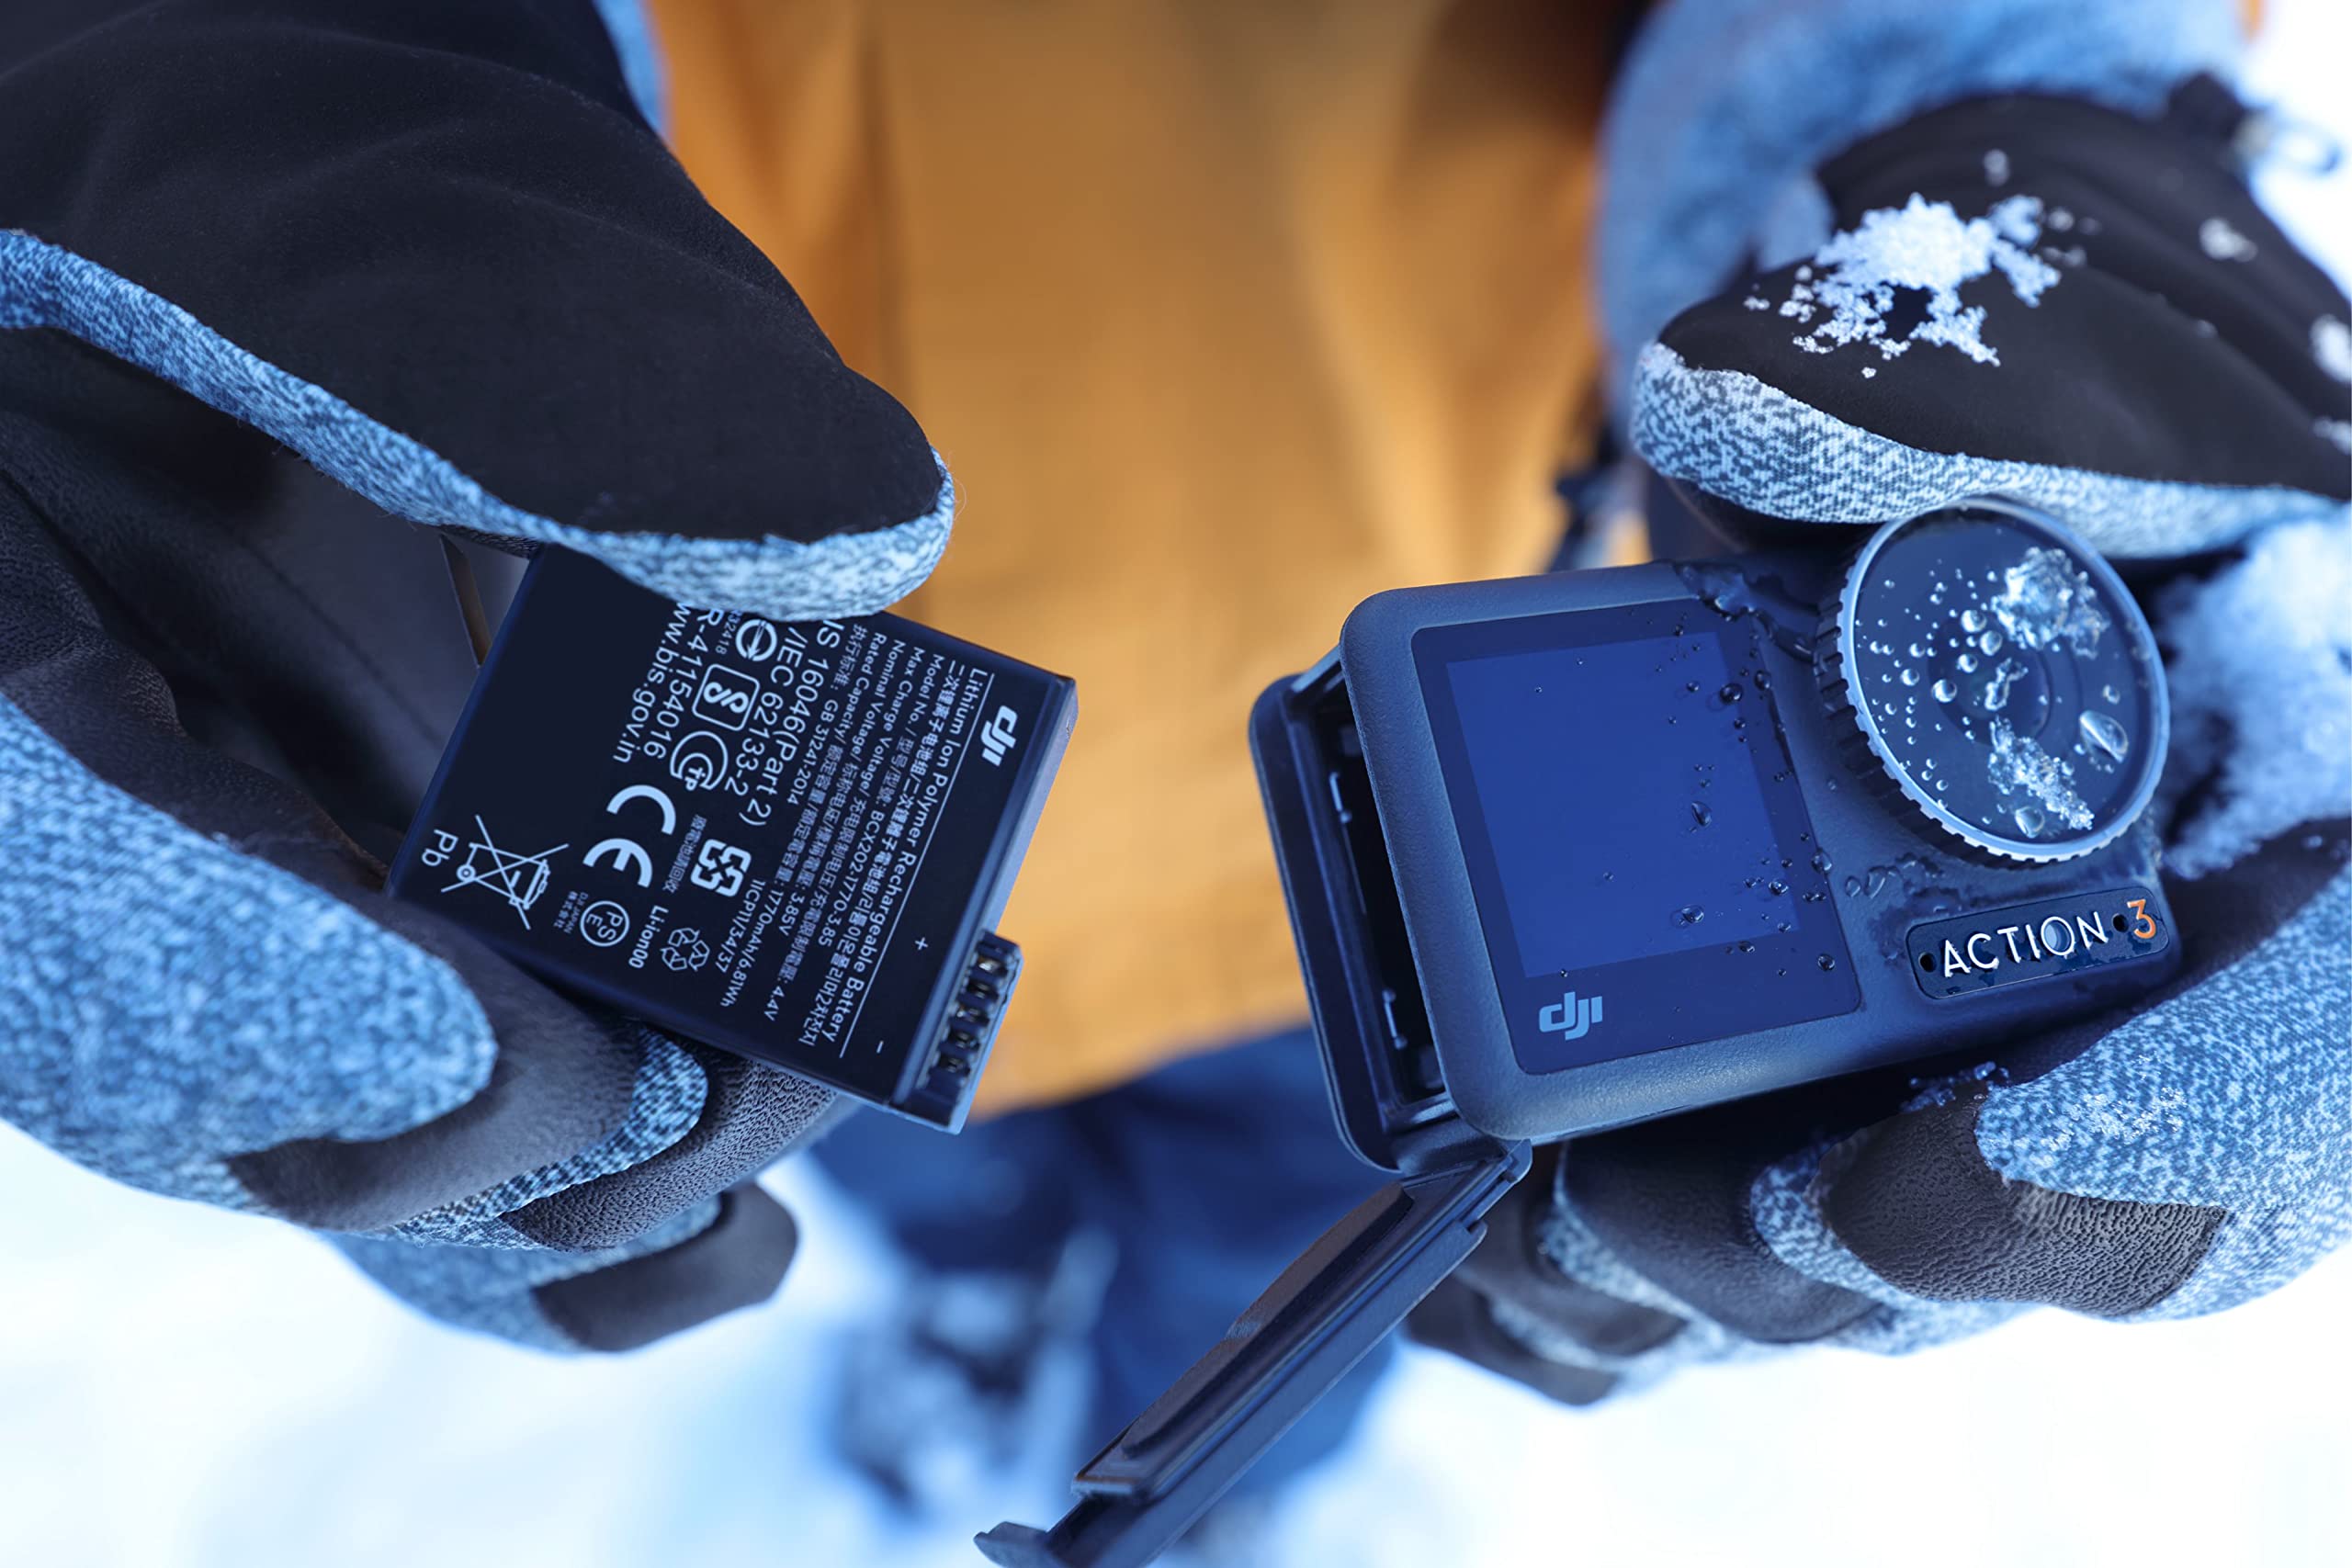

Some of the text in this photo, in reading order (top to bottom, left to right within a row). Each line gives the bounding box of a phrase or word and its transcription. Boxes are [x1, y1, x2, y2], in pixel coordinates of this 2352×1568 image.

[613, 603, 691, 763] ww.bis.gov.in
[643, 607, 723, 759] R-41154016
[861, 632, 888, 675] Rated
[874, 639, 907, 698] Nominal
[904, 646, 925, 676] Max
[918, 653, 945, 699] Model
[724, 626, 808, 796] /IEC 62133-2
[739, 616, 844, 826] IS 16046(Part 2)
[820, 699, 839, 723] GB
[833, 676, 870, 744] Capacity/
[850, 702, 884, 761] Voltage/
[883, 680, 913, 732] Charge
[908, 701, 928, 725] No.
[786, 724, 830, 805] 31241-2014
[858, 737, 893, 797] Voltage/
[421, 829, 458, 867] Pb
[582, 784, 676, 888] CE
[821, 668, 989, 1043] Lithium Ion Polymer Rechargeable Battery
[818, 809, 886, 947] BCX202-1770-3.85
[628, 905, 669, 969] Li-ion00
[778, 892, 806, 936] 3.85V
[1943, 898, 2157, 978] ACTION 3
[720, 889, 785, 1007] 1770mAh/6.81Wh
[763, 986, 785, 1021] 4.4V
